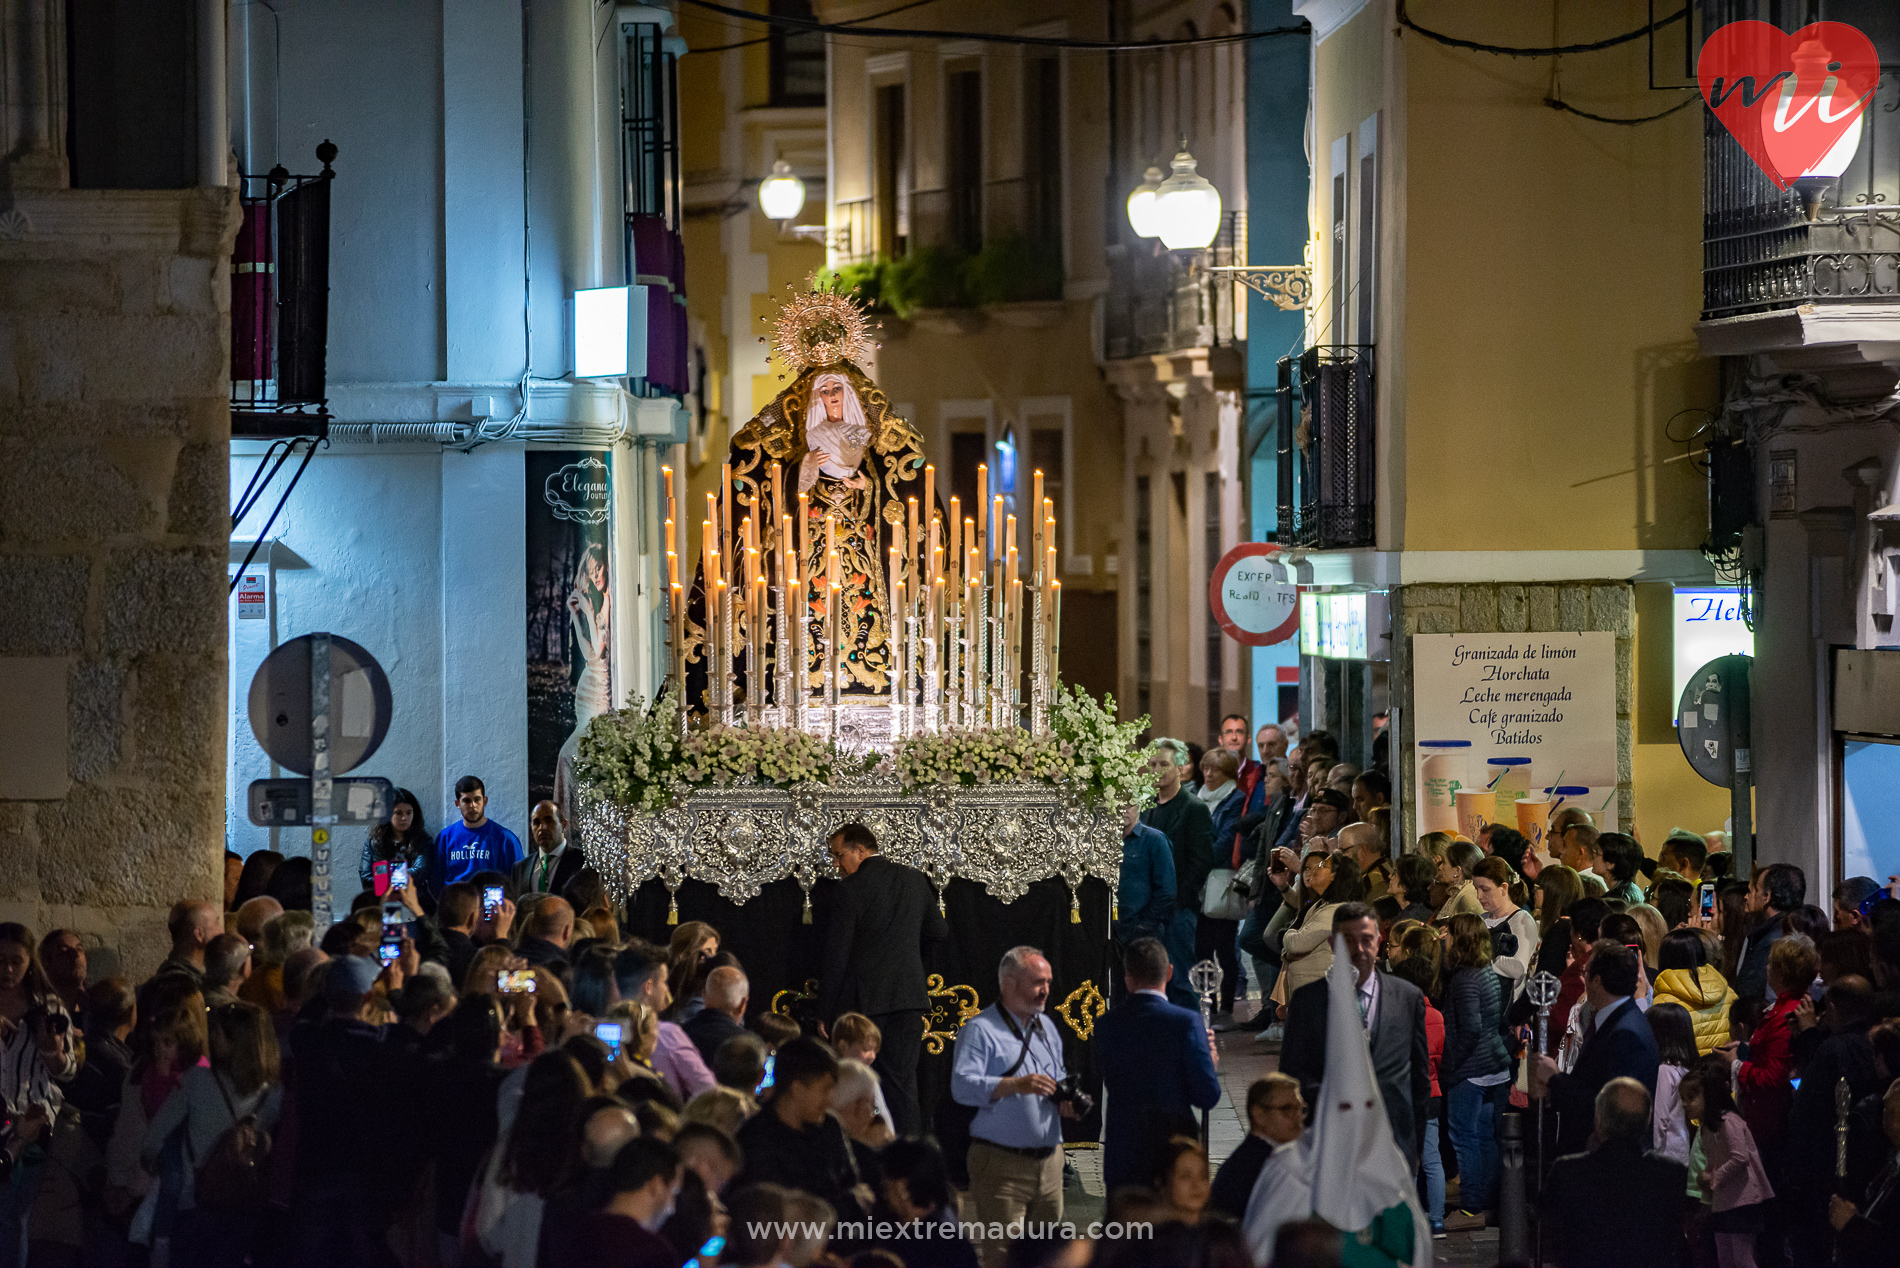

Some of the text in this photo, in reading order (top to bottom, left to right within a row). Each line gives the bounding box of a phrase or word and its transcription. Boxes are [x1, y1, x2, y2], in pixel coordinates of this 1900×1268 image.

[1451, 644, 1577, 667] Granizada de limón
[1480, 665, 1550, 682] Horchata
[1459, 686, 1572, 707] Leche merengada
[1469, 707, 1564, 729] Café granizado
[1490, 729, 1543, 745] Batidos
[450, 849, 490, 861] HOLLISTER
